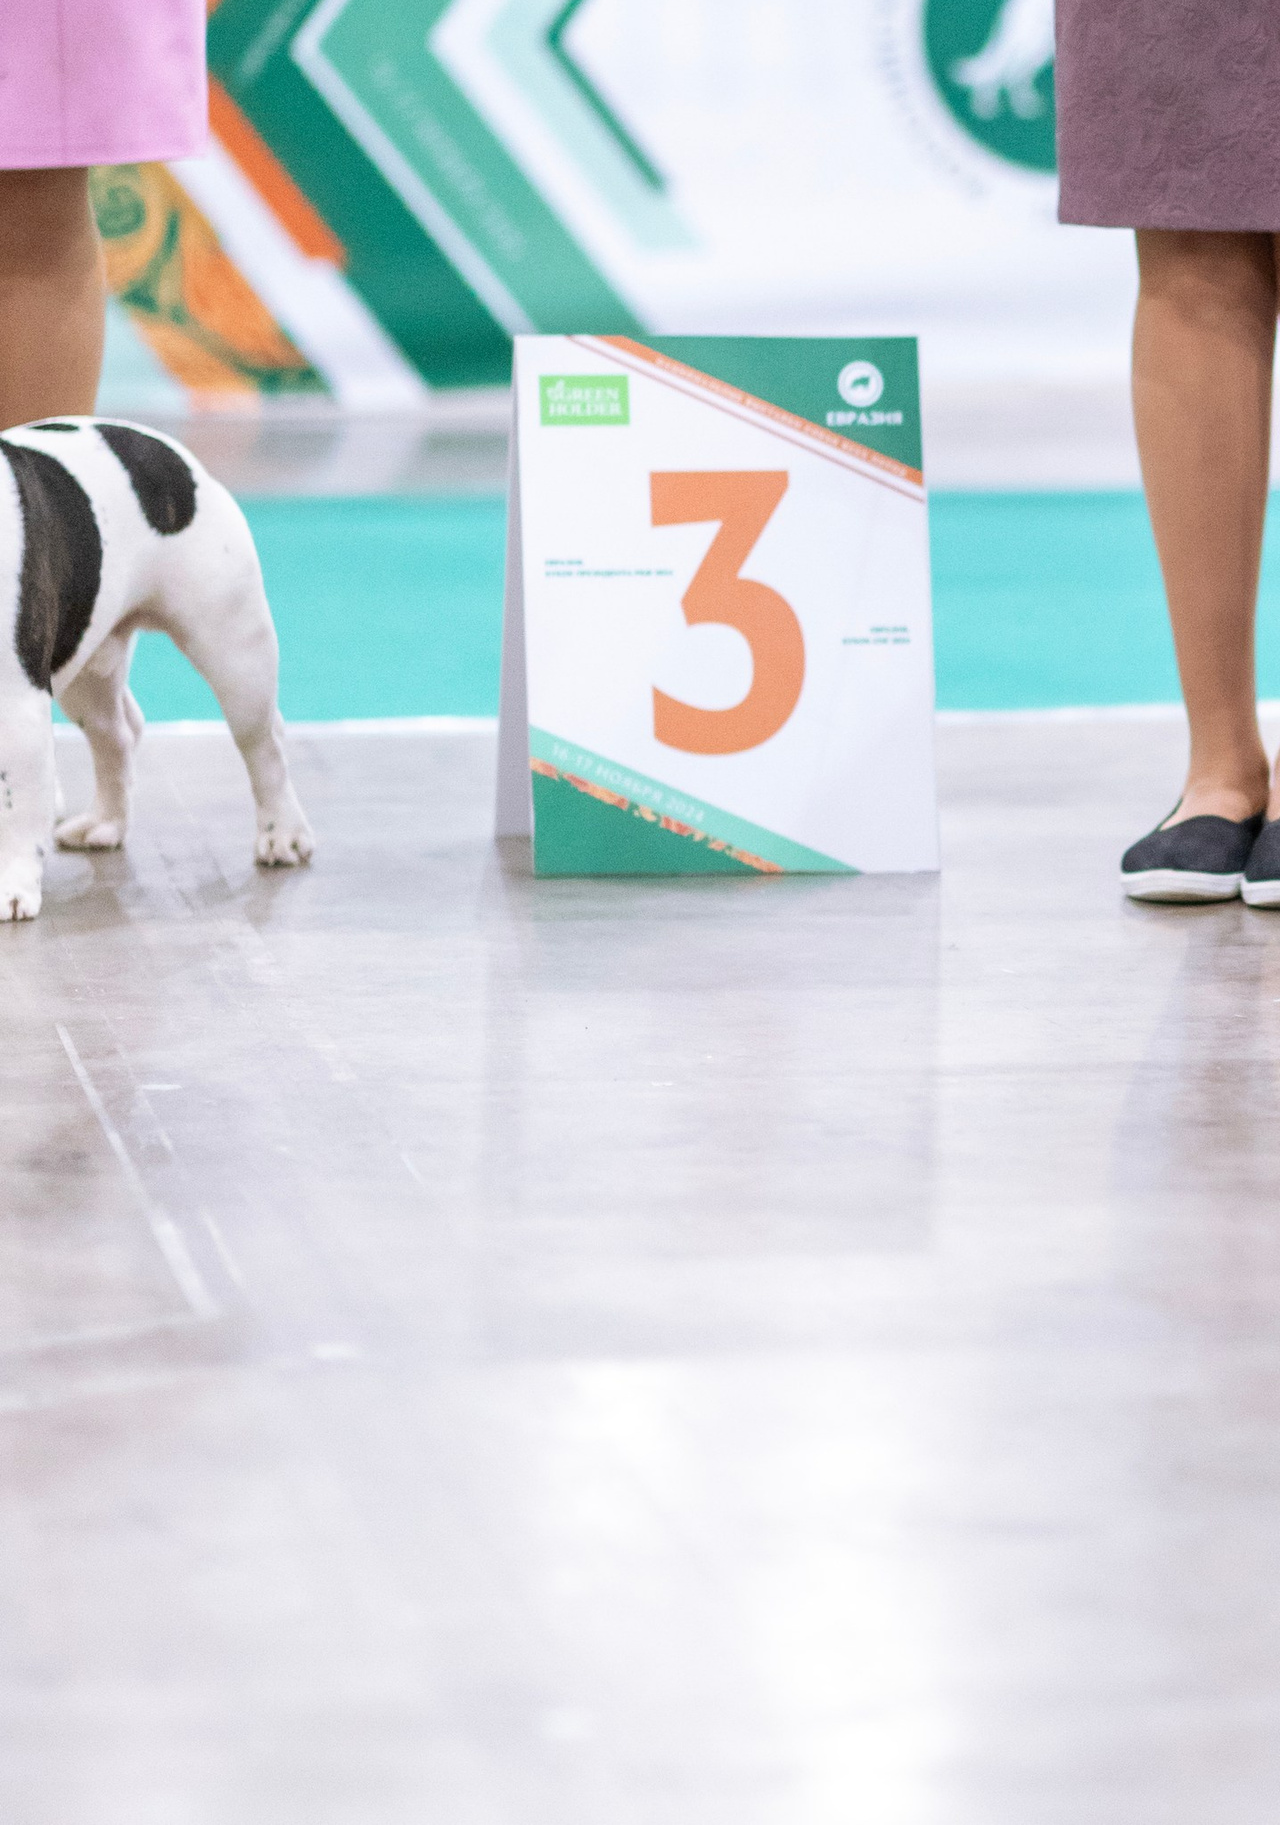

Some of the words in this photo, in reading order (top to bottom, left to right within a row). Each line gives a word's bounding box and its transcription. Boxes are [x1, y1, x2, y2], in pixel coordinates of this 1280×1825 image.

[548, 401, 622, 417] HOLDER
[825, 410, 903, 427] ЕВРАЗИЯ
[650, 470, 806, 756] 3
